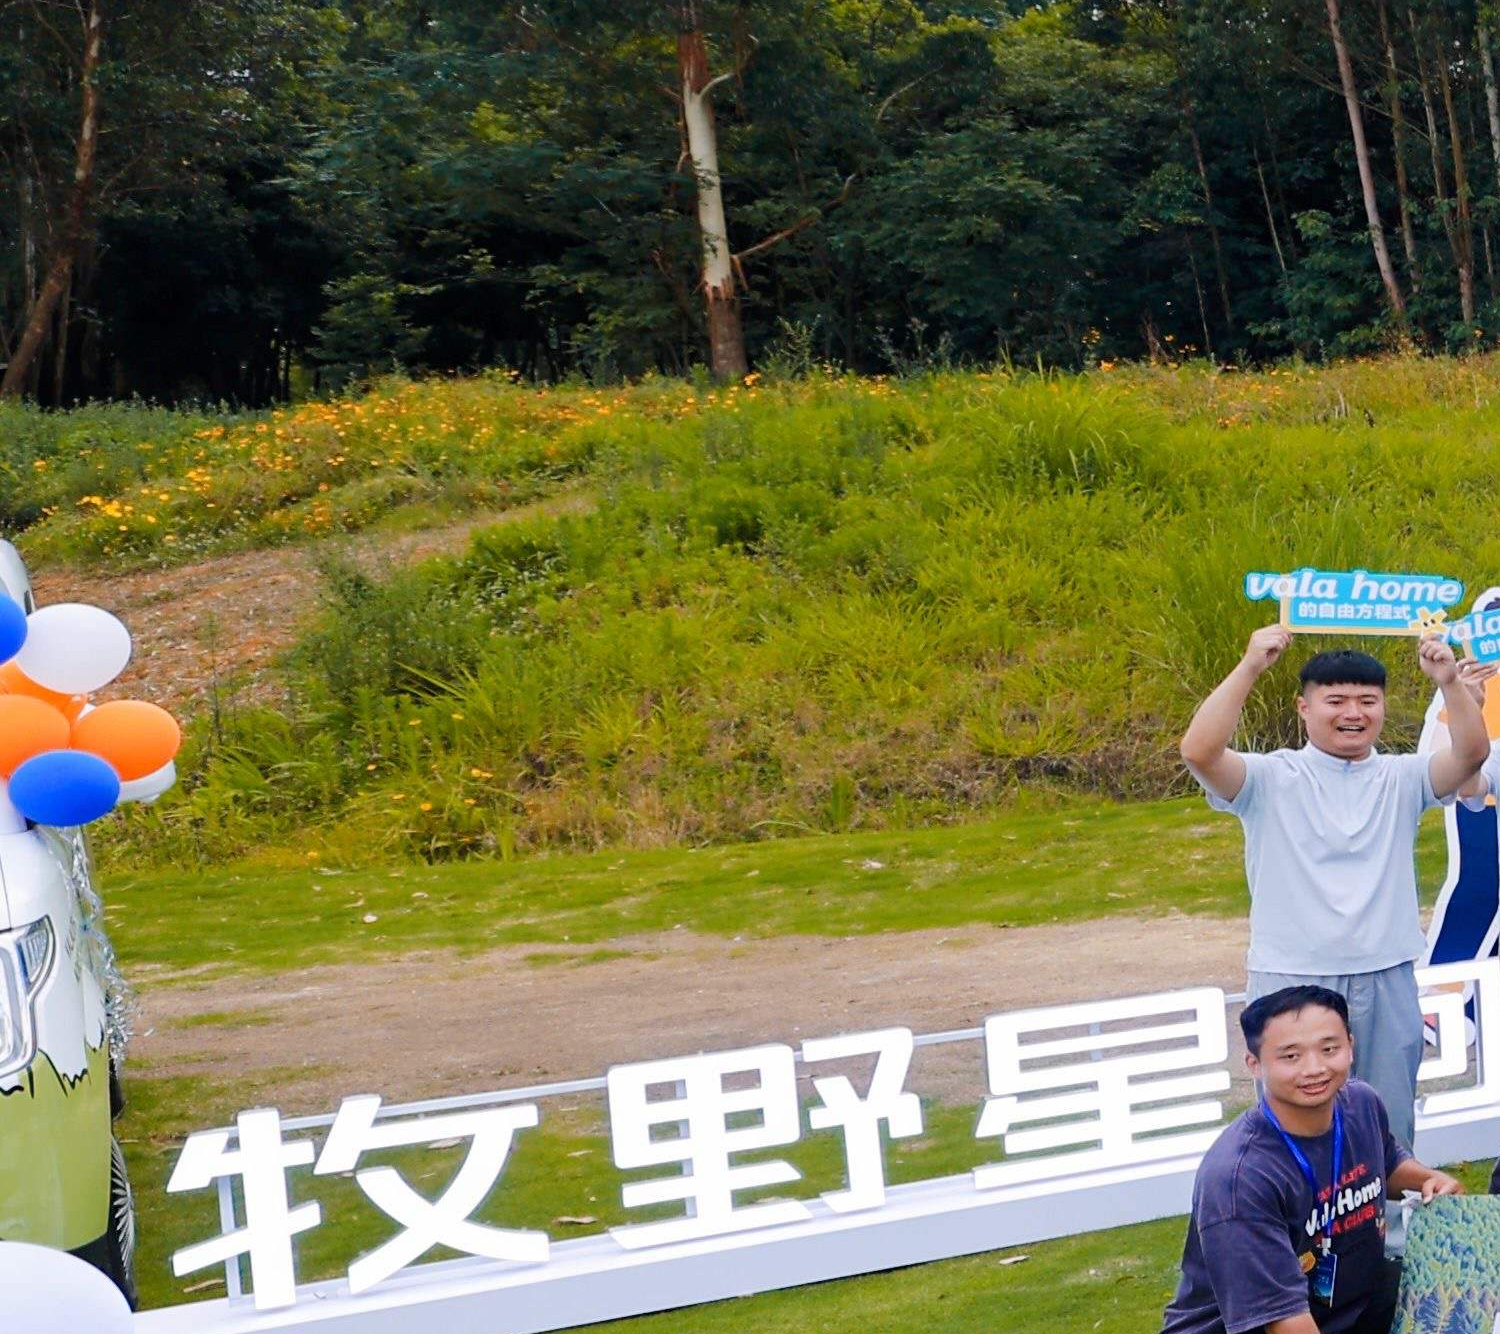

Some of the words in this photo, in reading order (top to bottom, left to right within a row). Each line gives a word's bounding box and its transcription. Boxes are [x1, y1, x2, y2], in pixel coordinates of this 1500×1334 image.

[1246, 571, 1339, 600] vala
[1350, 573, 1463, 604] home
[1298, 602, 1412, 620] 的自由方程式
[1337, 1176, 1382, 1215] Home
